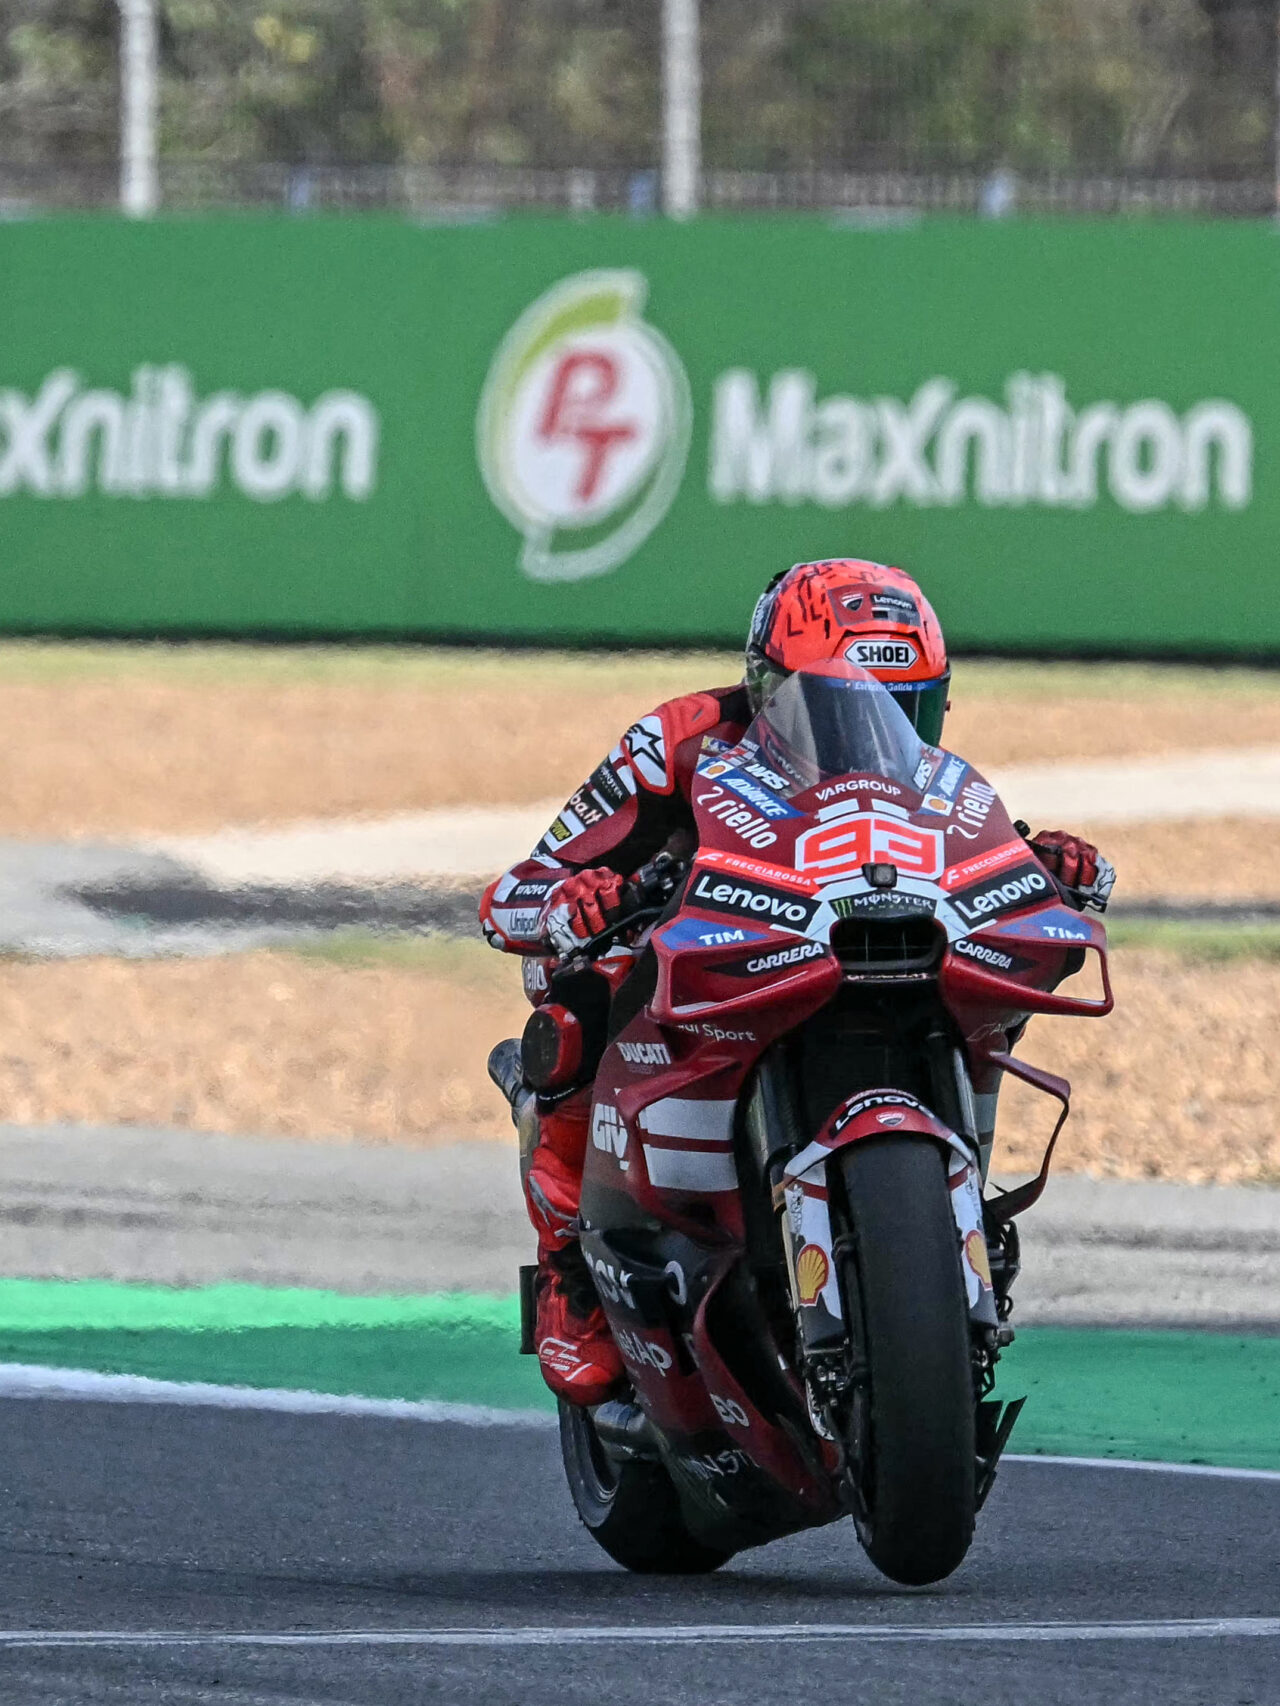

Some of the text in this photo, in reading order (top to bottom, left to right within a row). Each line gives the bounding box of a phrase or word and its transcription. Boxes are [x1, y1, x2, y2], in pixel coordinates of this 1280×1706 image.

[709, 369, 1253, 509] Maxnitron
[856, 646, 910, 663] SHOEI
[744, 763, 790, 790] WRS
[815, 779, 902, 802] VARGROUP
[956, 781, 997, 828] riello
[708, 800, 778, 849] riello
[725, 858, 812, 886] FRECCIAROSSA
[695, 875, 807, 921] Lenovo
[854, 892, 934, 911] MONSTER
[955, 873, 1046, 919] Lenovo
[699, 929, 744, 946] TIM
[1043, 926, 1086, 940] TIM
[746, 942, 824, 973] CARRERA
[955, 939, 1013, 970] CARRERA
[702, 1023, 757, 1042] Sport
[616, 1042, 671, 1065] DUCATI
